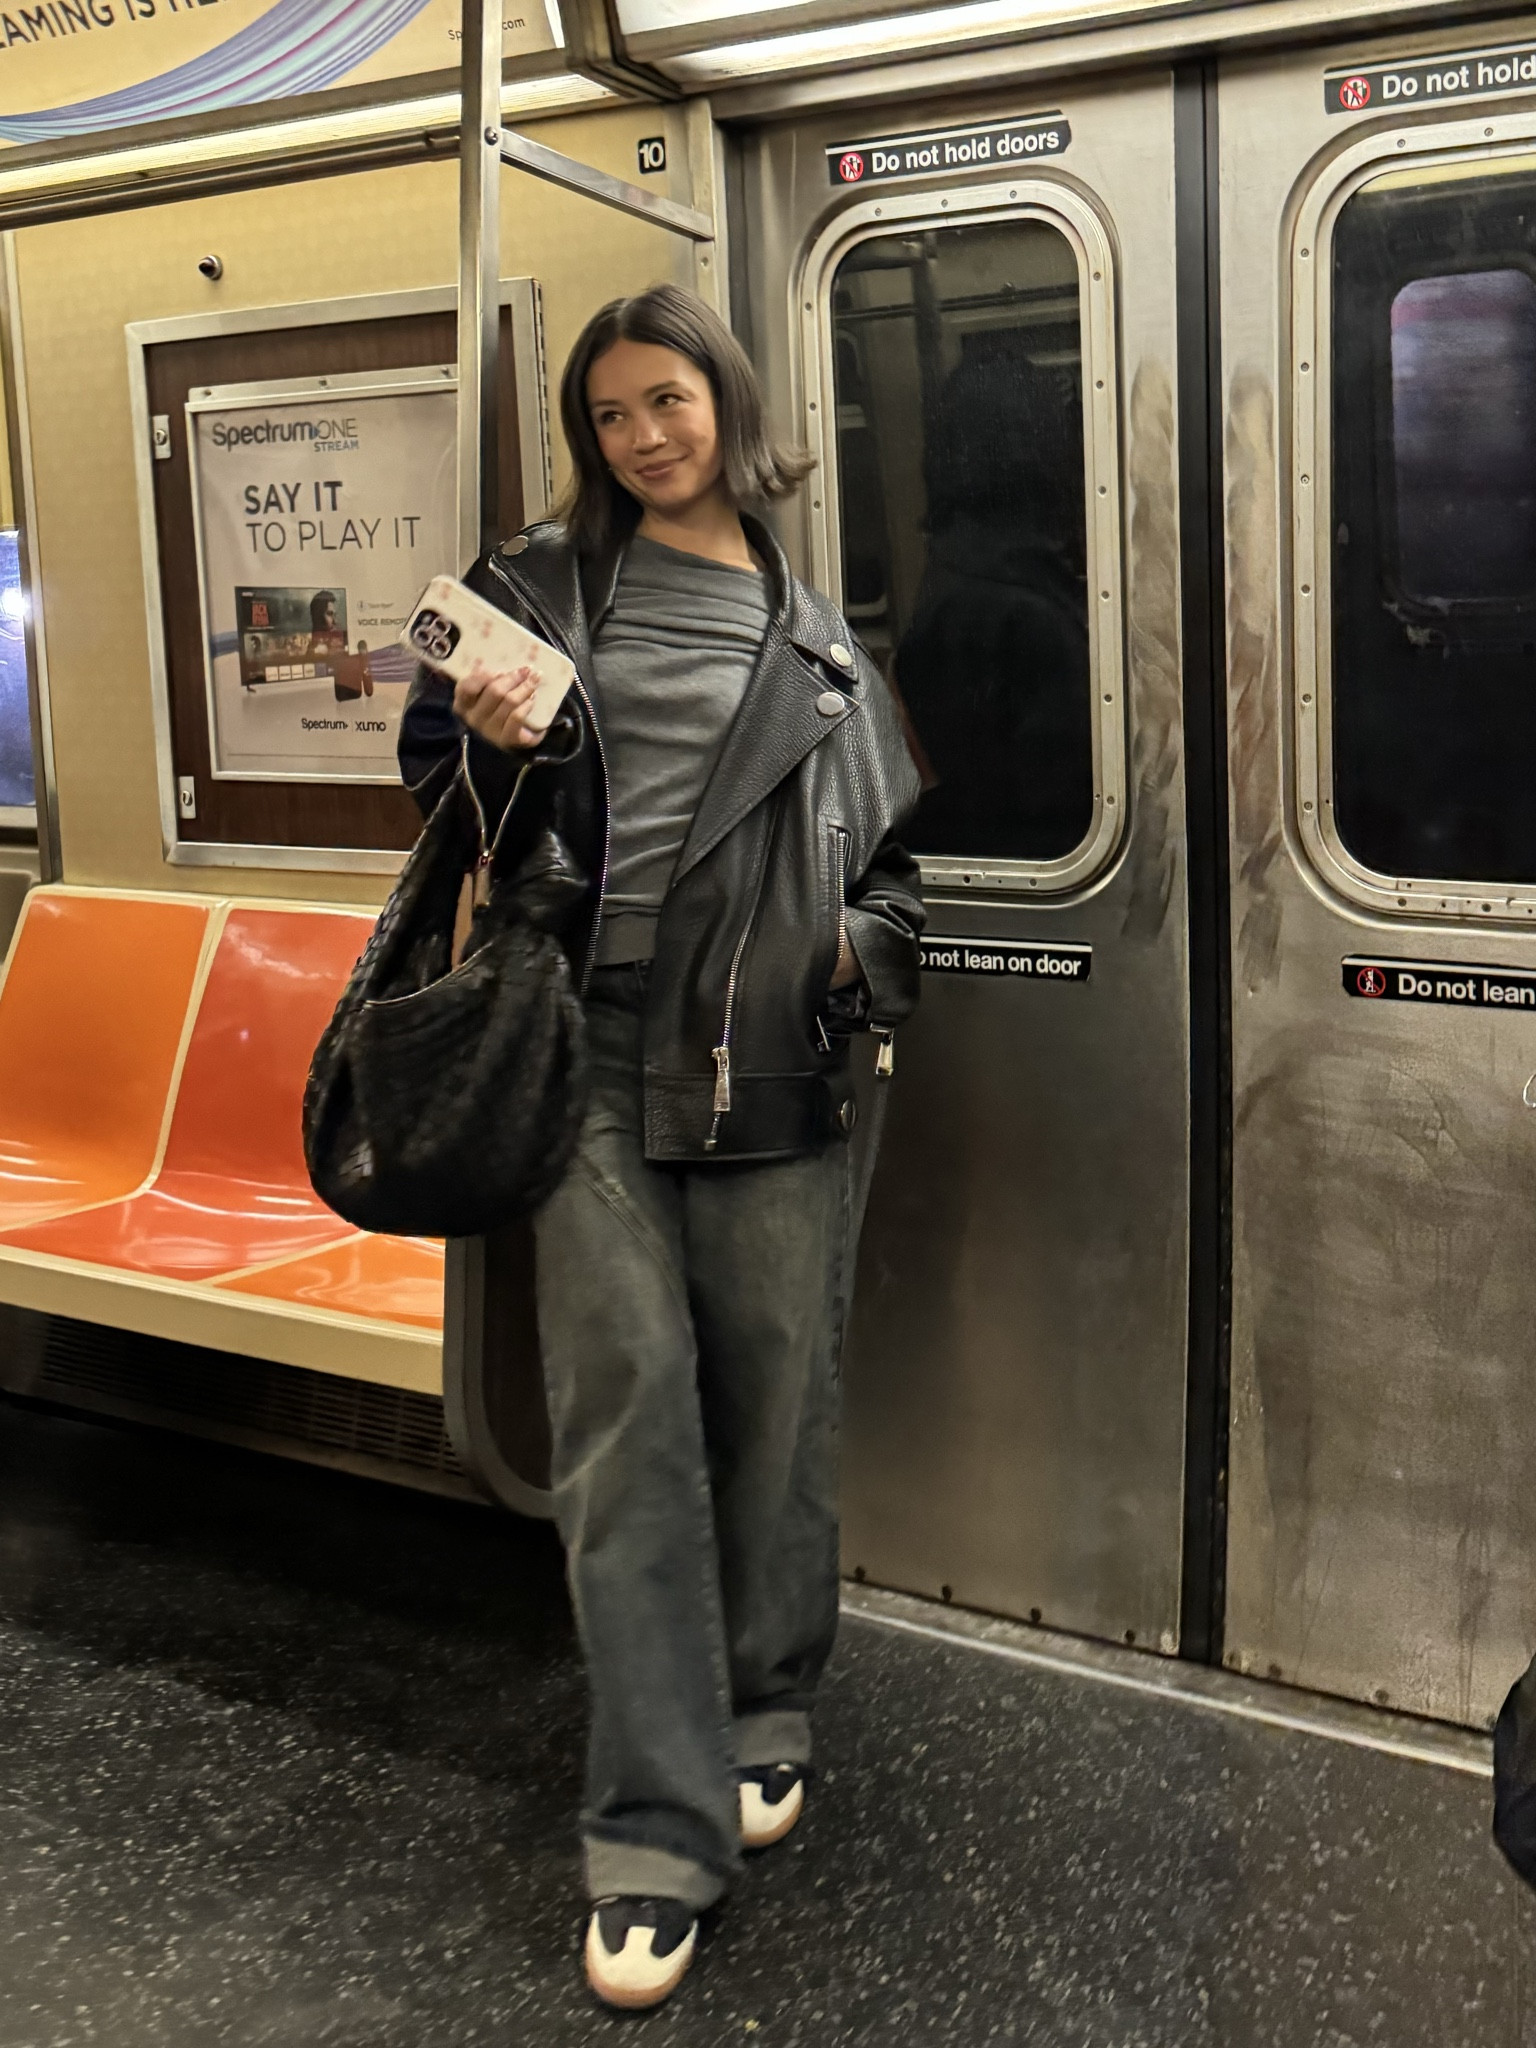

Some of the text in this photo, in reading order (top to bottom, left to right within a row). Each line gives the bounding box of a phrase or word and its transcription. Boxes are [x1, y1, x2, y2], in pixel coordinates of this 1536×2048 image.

[0, 0, 115, 48] AMING
[1382, 54, 1536, 99] Do not hold
[639, 142, 663, 169] 10
[871, 129, 1060, 174] Do not hold doors
[212, 419, 314, 452] Spectrum
[314, 440, 360, 452] STREAM
[244, 480, 344, 515] SAY IT
[246, 516, 421, 553] TO PLAY IT
[301, 718, 346, 731] Spectrum
[929, 949, 960, 968] not
[965, 949, 1004, 971] lean
[1008, 957, 1032, 973] on
[1036, 953, 1082, 976] door
[1398, 973, 1536, 1005] Do not lean
